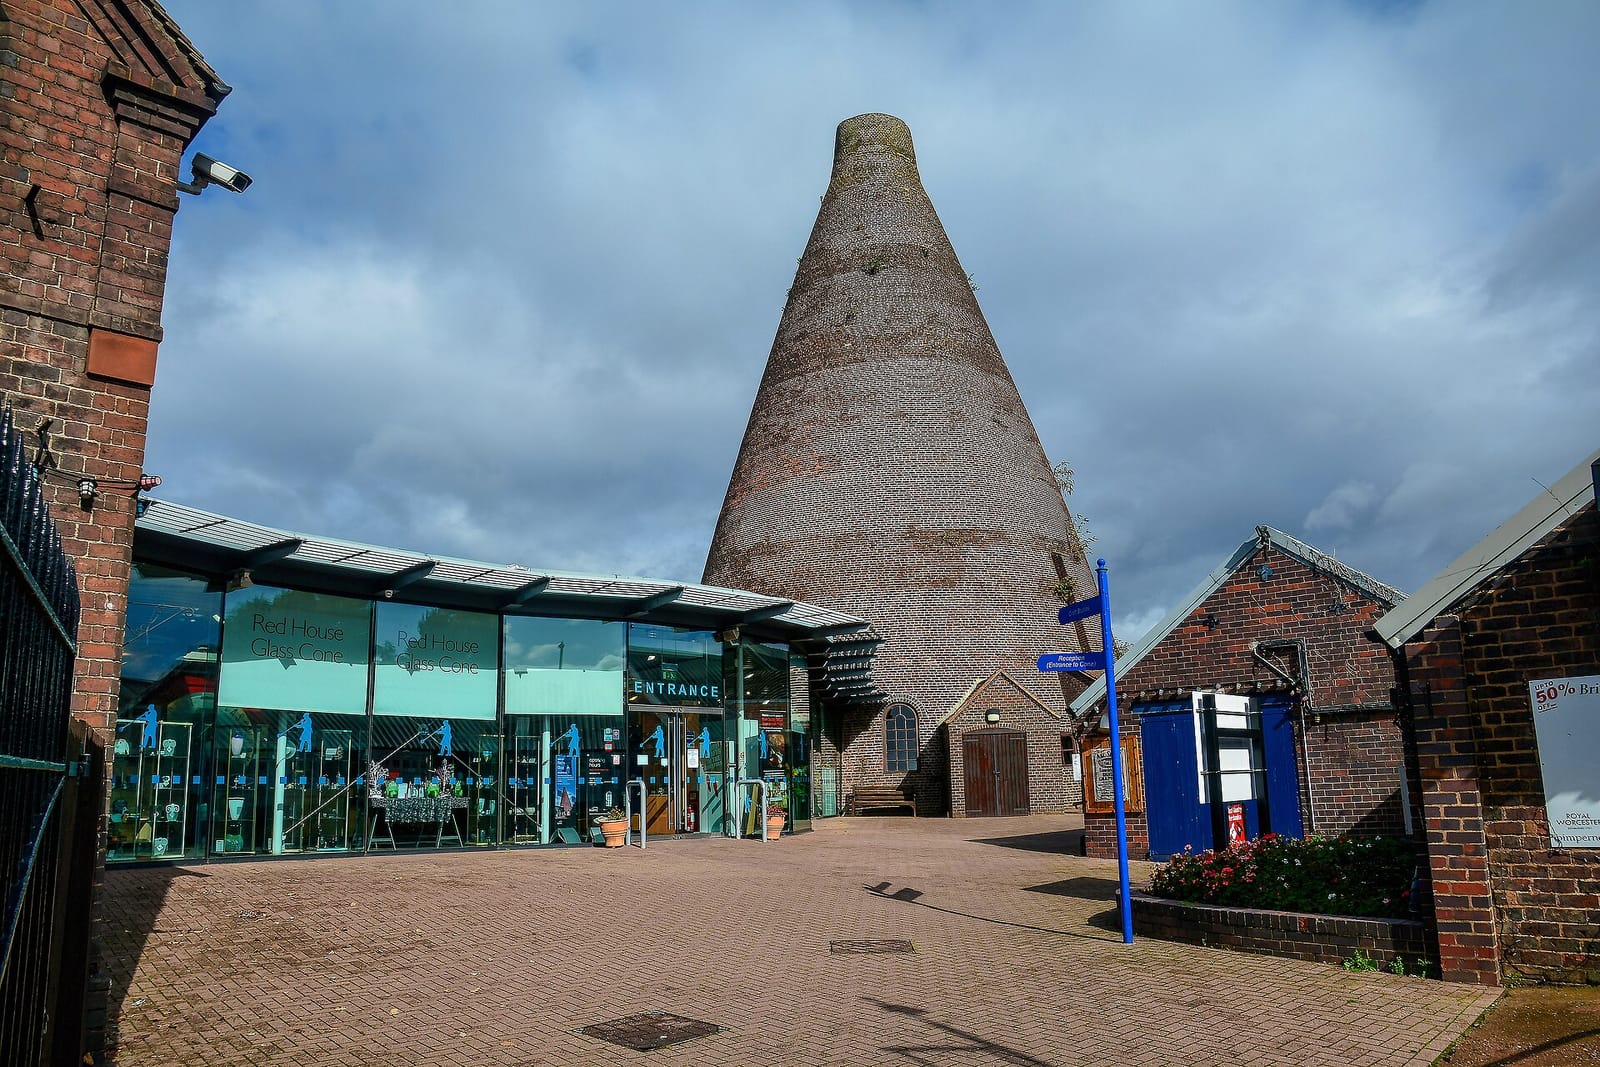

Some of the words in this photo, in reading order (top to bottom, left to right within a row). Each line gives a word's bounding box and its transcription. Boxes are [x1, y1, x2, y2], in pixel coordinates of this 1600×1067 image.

[252, 613, 287, 635] Red
[291, 617, 344, 641] House
[251, 637, 294, 659] Glass
[298, 642, 344, 663] Cone
[397, 630, 428, 649] Red
[432, 633, 479, 654] House
[396, 652, 434, 671] Glass
[438, 655, 479, 675] Cone
[634, 681, 719, 698] ENTRANCE
[1536, 681, 1576, 704] 50%
